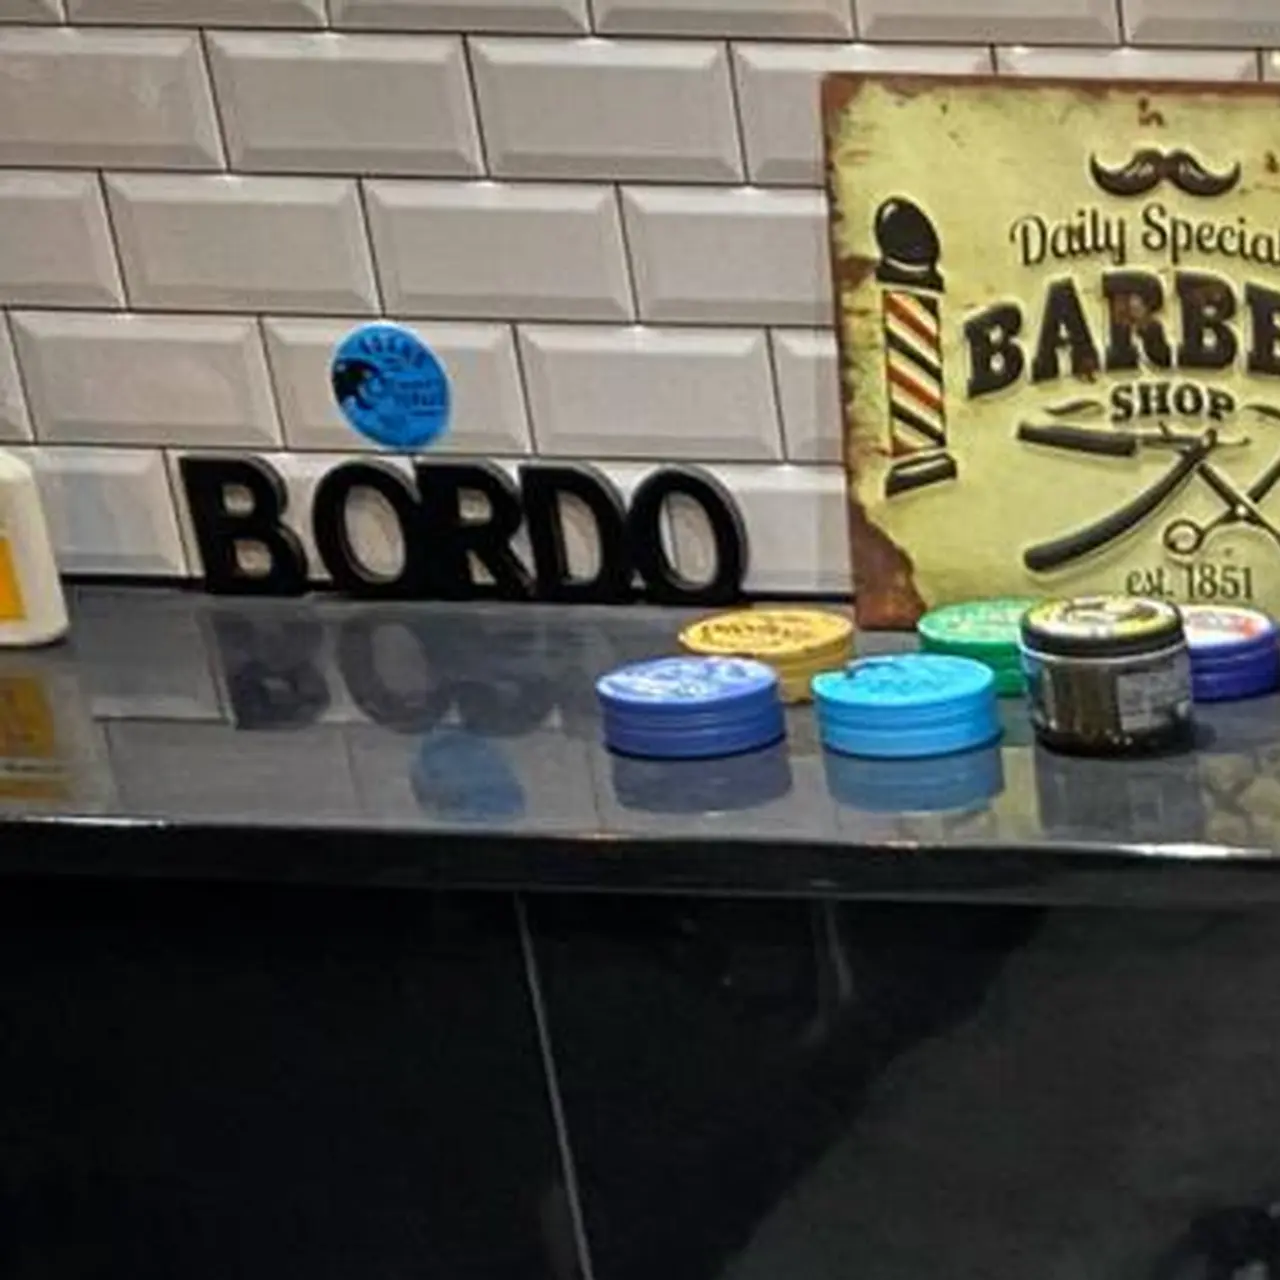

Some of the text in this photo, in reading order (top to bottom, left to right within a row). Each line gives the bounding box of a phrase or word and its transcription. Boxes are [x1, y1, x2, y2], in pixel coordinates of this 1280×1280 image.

[1009, 208, 1126, 266] Daily
[1111, 382, 1236, 422] SHOP
[179, 453, 748, 600] BORDO
[1126, 563, 1253, 600] est. 1851
